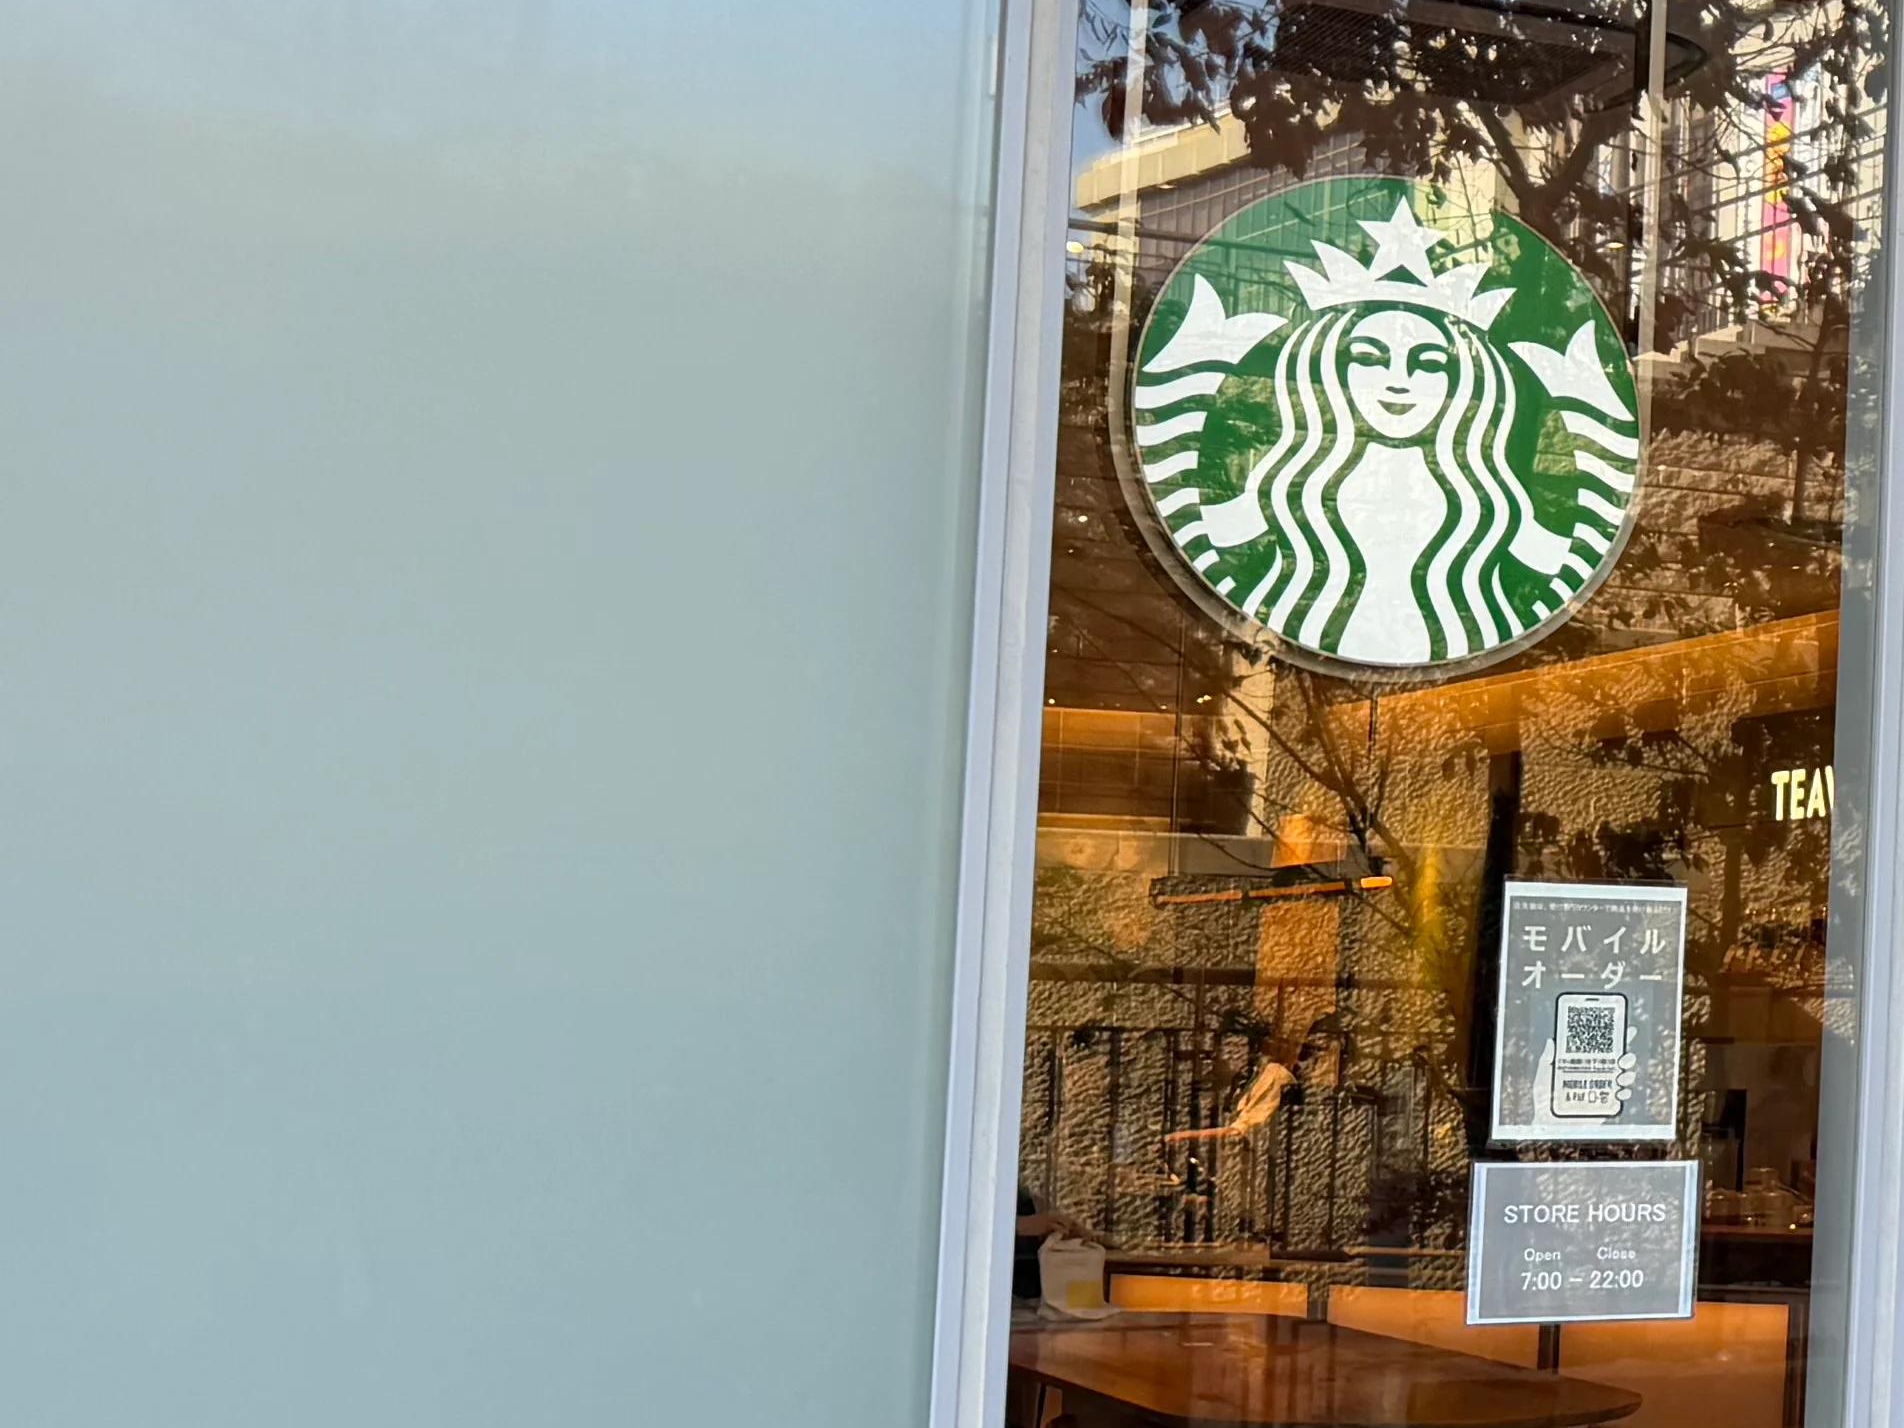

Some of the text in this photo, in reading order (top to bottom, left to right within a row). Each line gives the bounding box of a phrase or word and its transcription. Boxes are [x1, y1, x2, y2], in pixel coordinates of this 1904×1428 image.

[1522, 925, 1666, 955] モバイル
[1521, 960, 1663, 990] オーダー
[1503, 1203, 1667, 1224] STORE HOURS
[1523, 1246, 1637, 1264] Open Close
[1520, 1271, 1563, 1291] 7:00
[1588, 1270, 1645, 1289] 22:00
